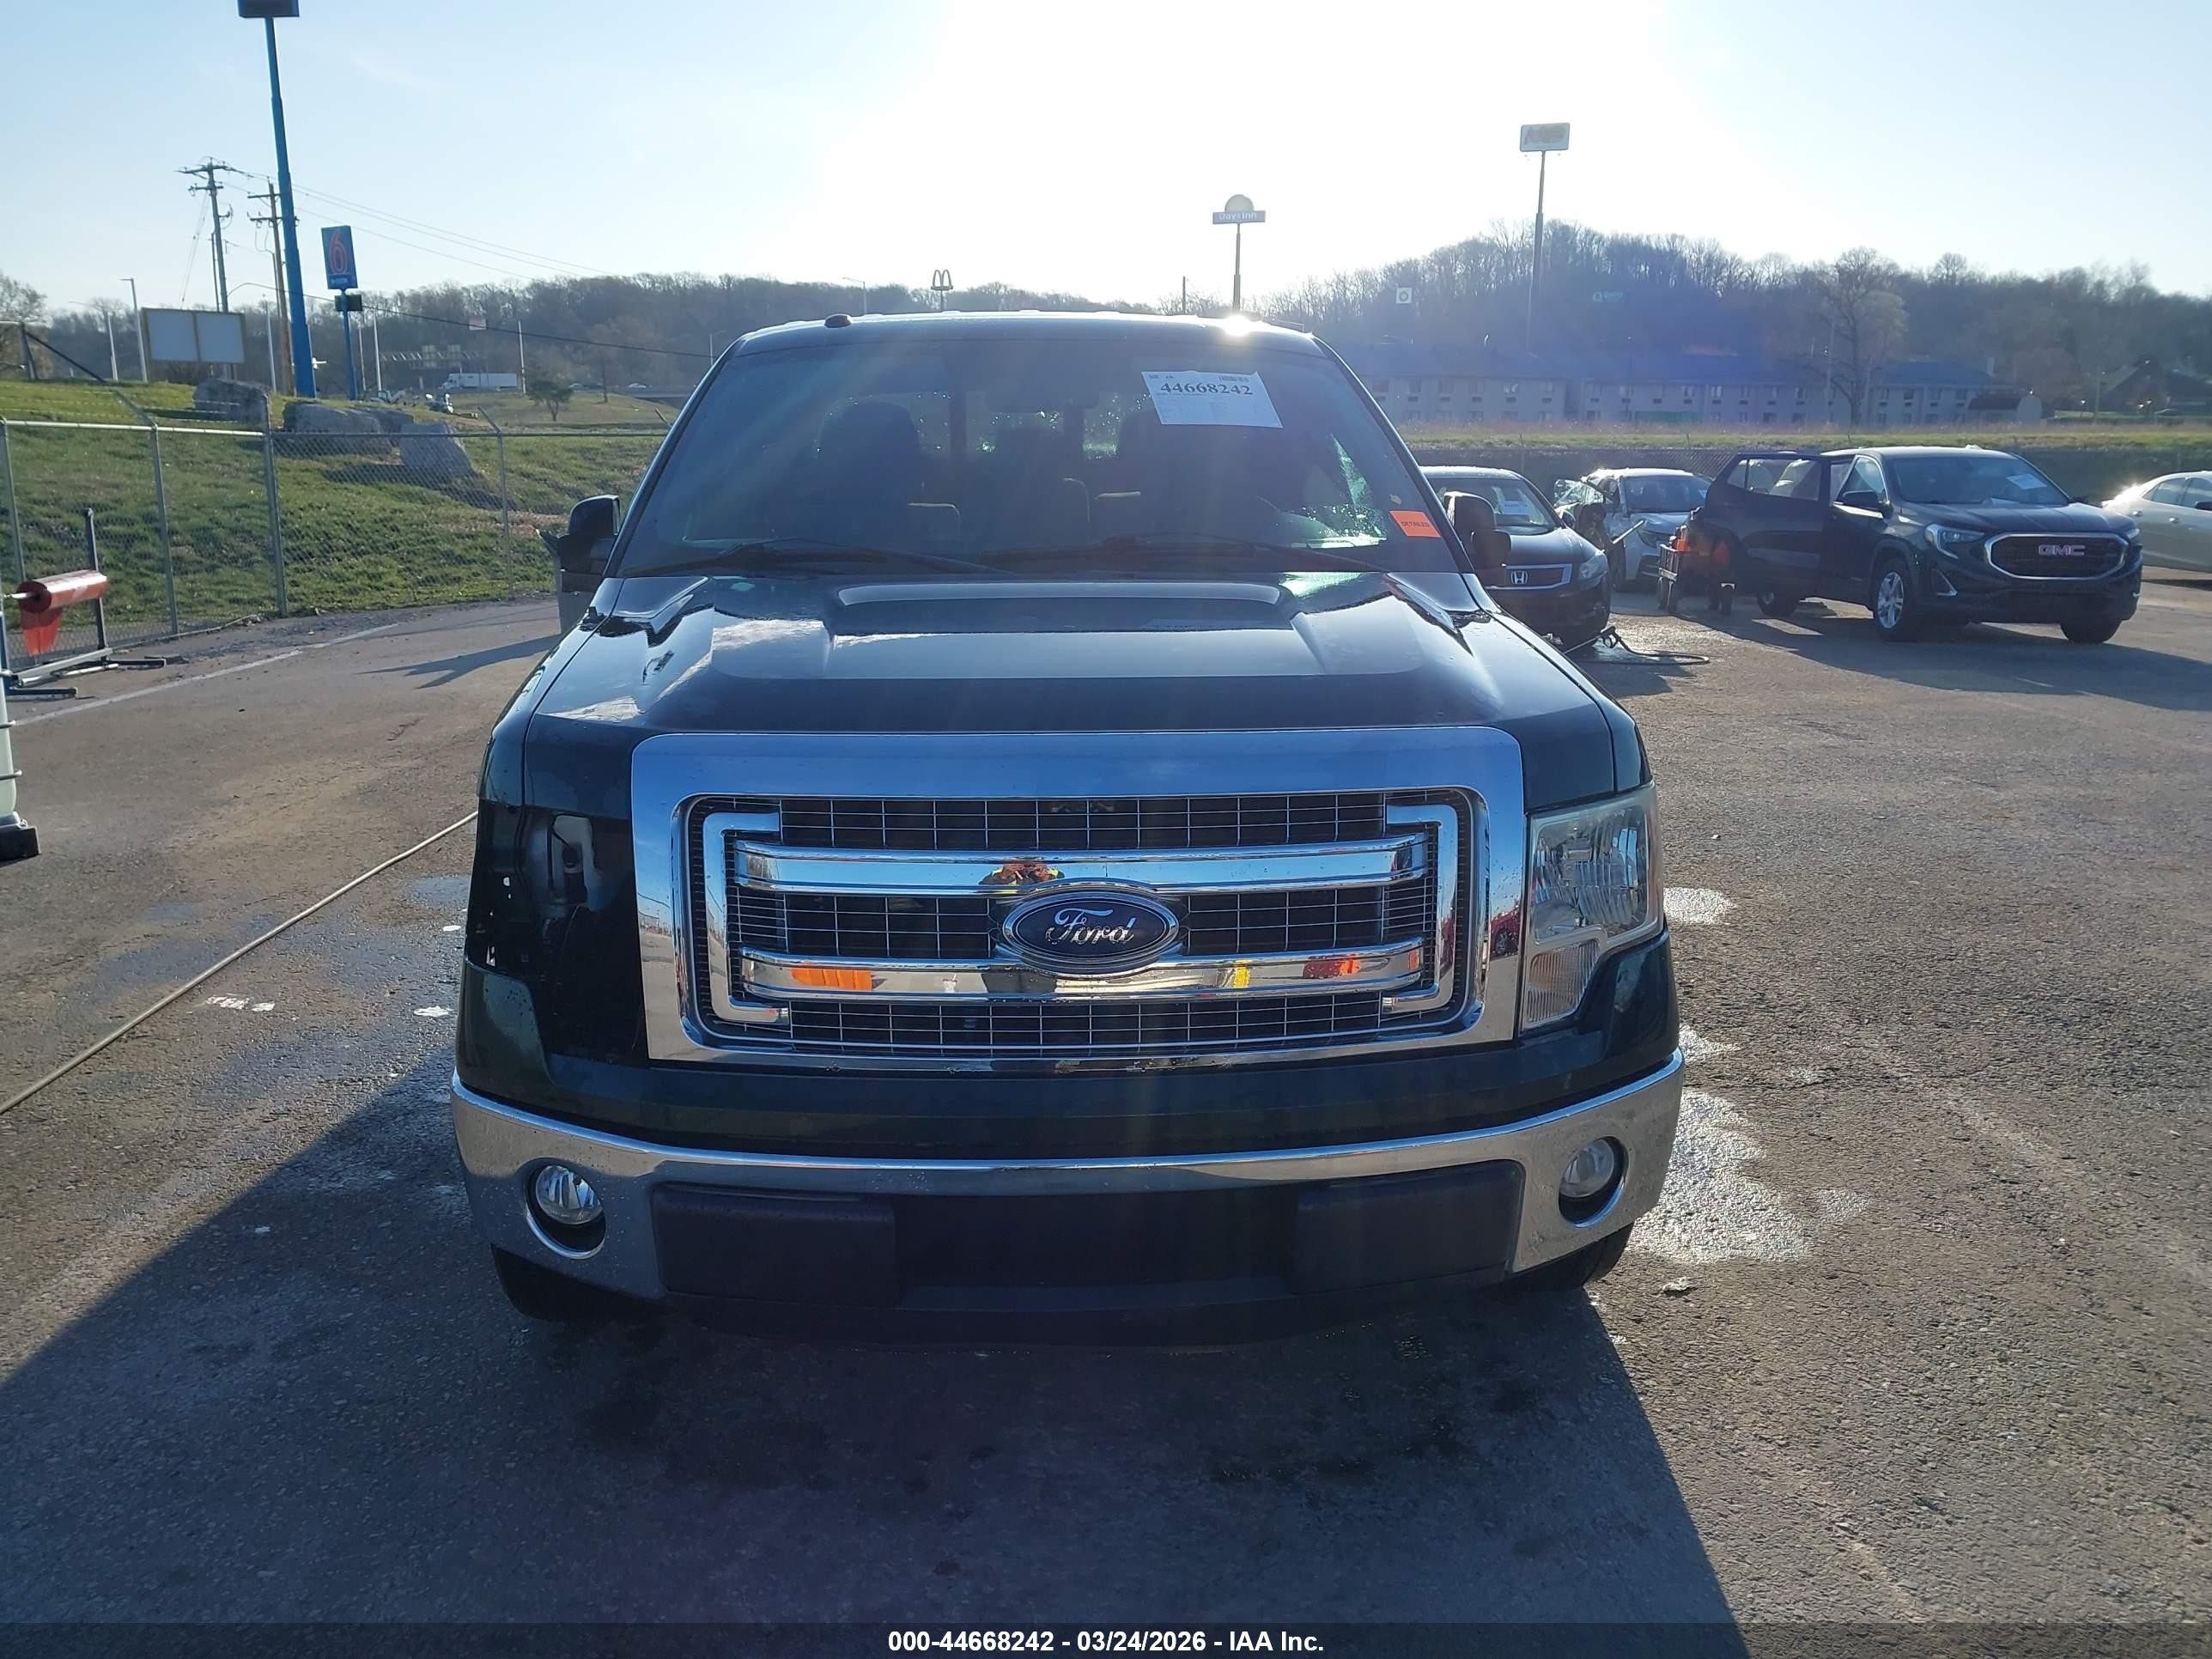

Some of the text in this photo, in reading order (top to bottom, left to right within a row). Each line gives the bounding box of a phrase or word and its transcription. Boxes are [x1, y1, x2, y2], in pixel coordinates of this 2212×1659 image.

[329, 229, 349, 275] 6
[1160, 382, 1254, 395] 44668242
[2039, 544, 2086, 556] GMC
[1045, 908, 1136, 945] Ford
